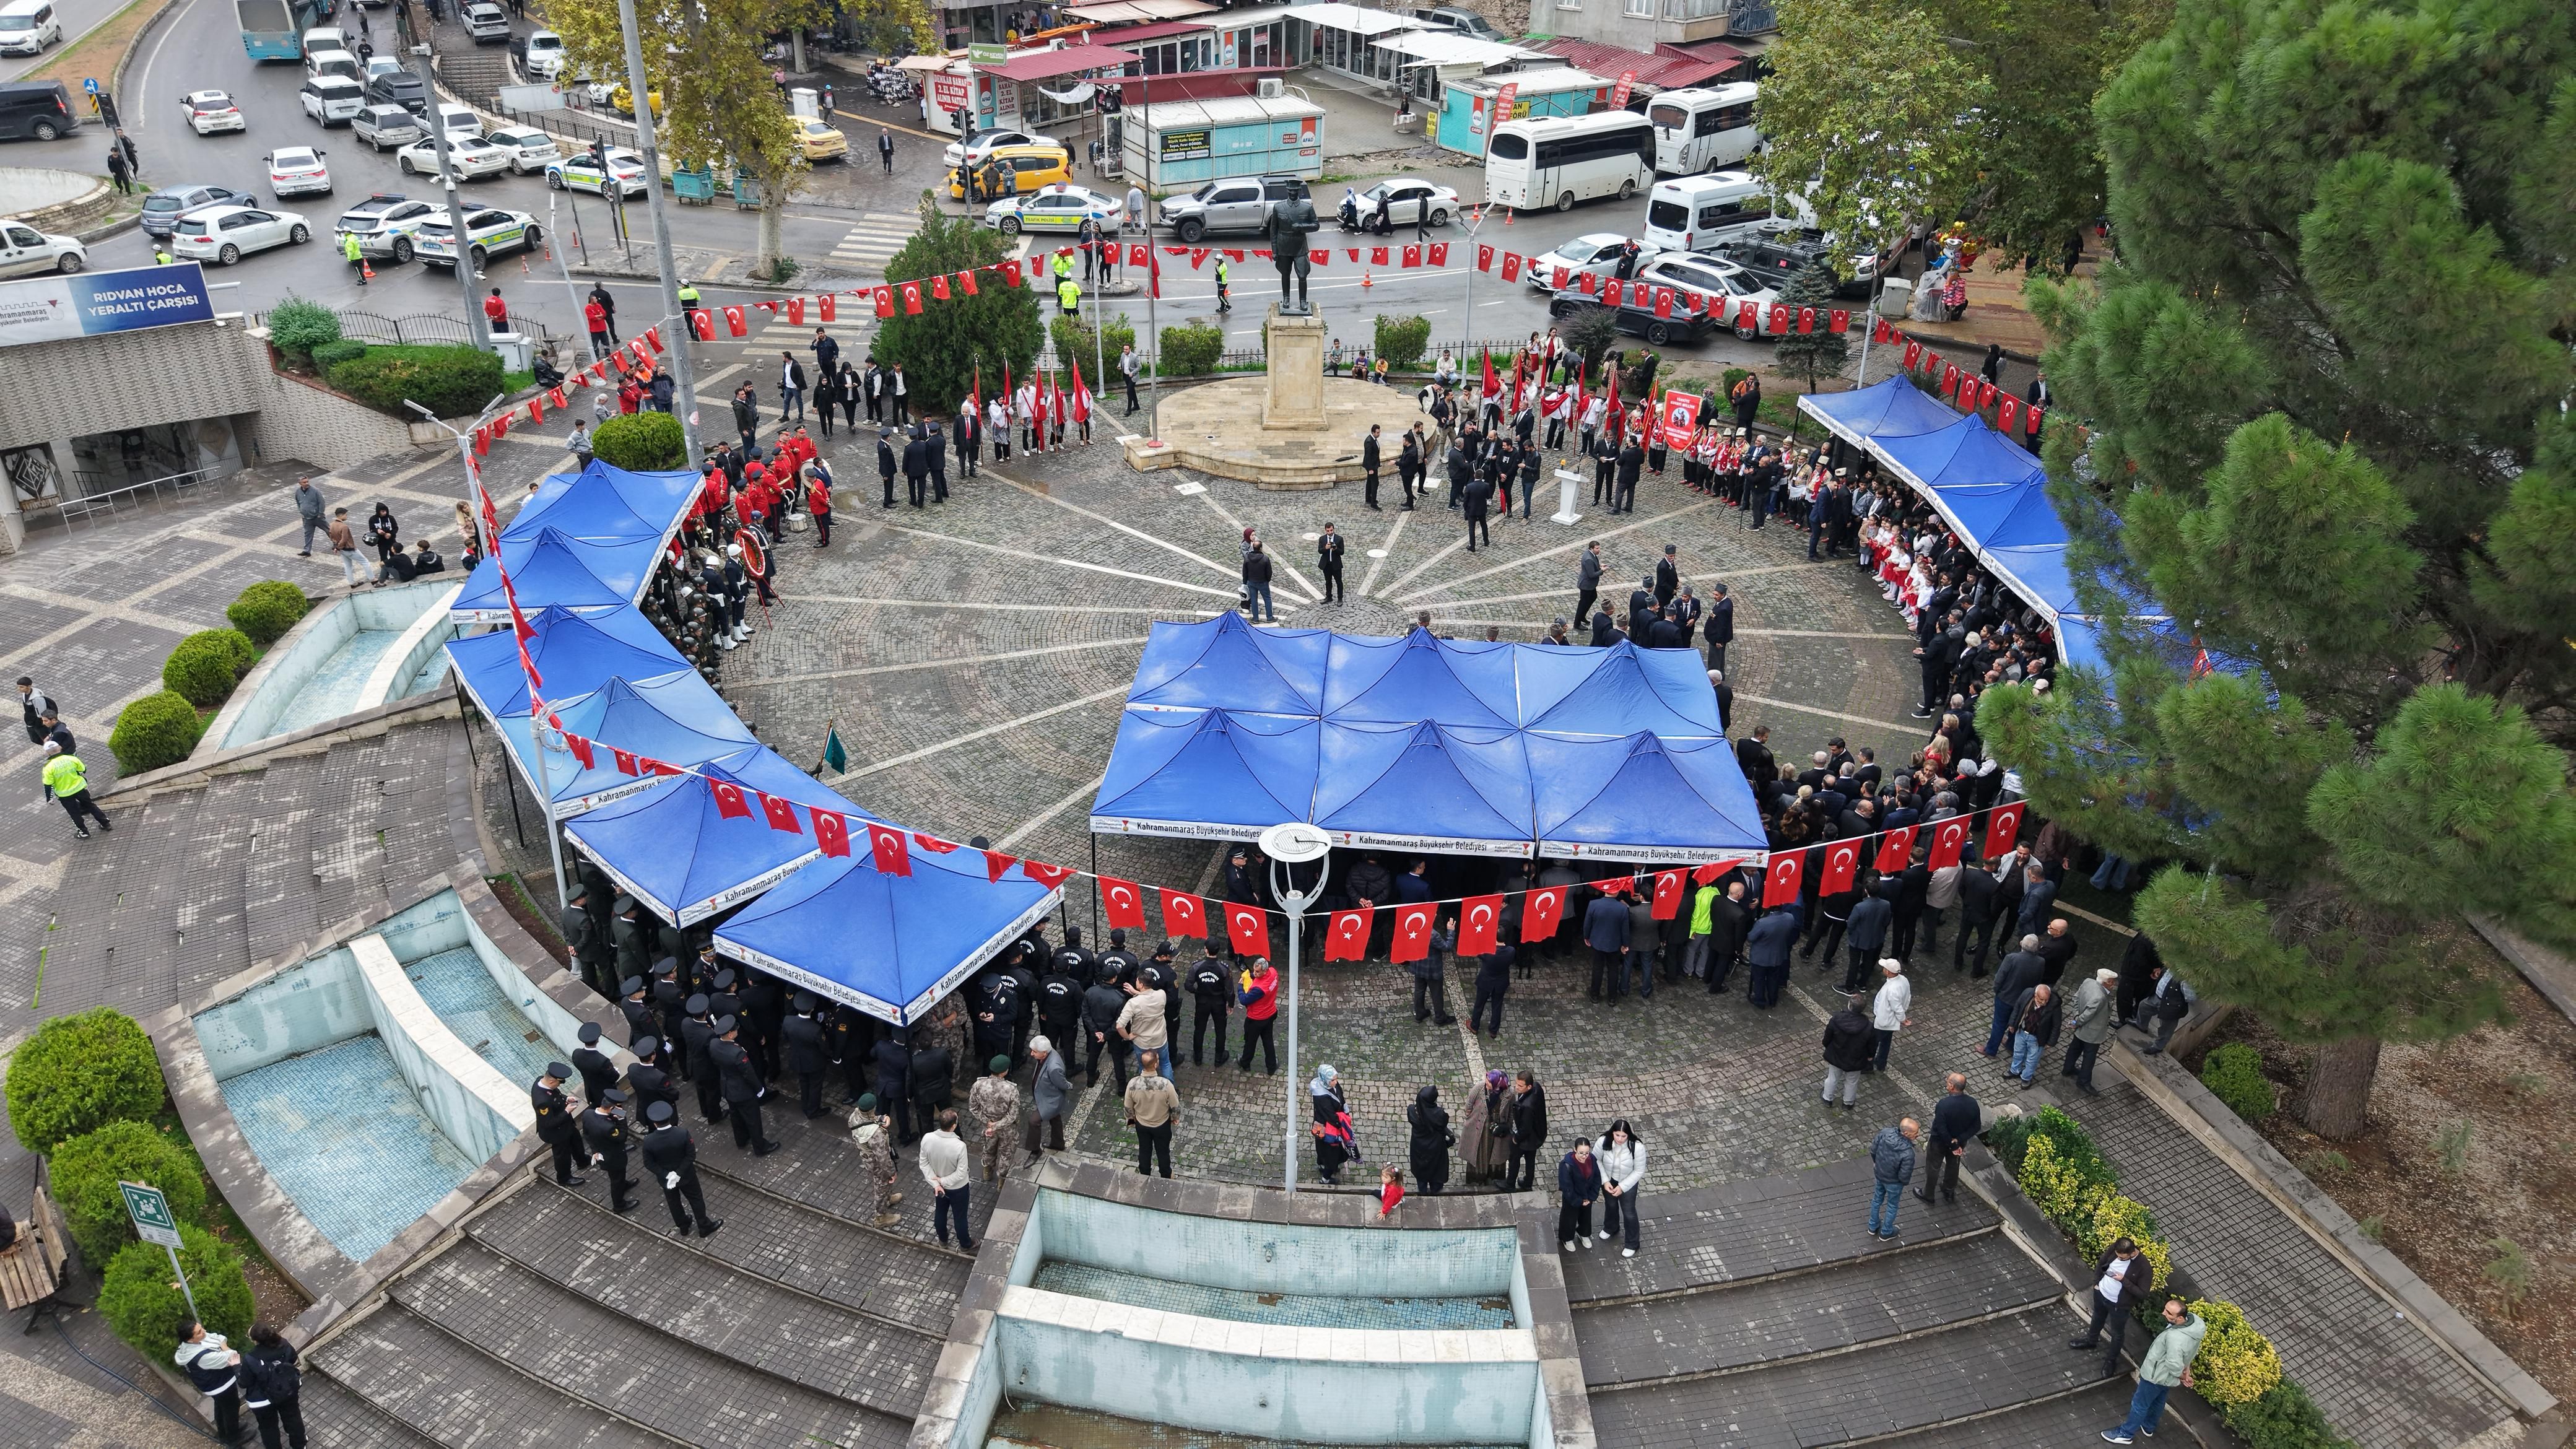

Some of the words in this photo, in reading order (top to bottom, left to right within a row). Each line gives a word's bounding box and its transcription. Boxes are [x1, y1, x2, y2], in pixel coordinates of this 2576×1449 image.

[952, 77, 967, 87] SAHAF
[943, 85, 950, 94] EL
[950, 85, 965, 96] KİTAP
[1510, 111, 1526, 119] FÖRÜ
[94, 287, 145, 303] RIDVAN
[146, 283, 186, 297] HOCA
[88, 301, 145, 318] YERALTI
[147, 295, 199, 312] ÇARŞISI
[23, 316, 50, 325] Belediyesi
[1137, 822, 1194, 834] Kahramanmaraş
[1196, 826, 1230, 837] Büyükşehir
[1231, 829, 1262, 838] Belediyesi
[1359, 835, 1418, 848] Kahramanmaraş
[1420, 838, 1453, 850] Büyükşehir
[1455, 841, 1487, 852] Belediyesi
[1588, 846, 1649, 859] Kahramanmaraş
[1651, 849, 1686, 859] Büyükşehir
[1687, 851, 1720, 861] Belediyesi
[724, 871, 781, 903] Kahramanmaraş
[940, 951, 986, 992] Kahramanmaraş
[986, 931, 1011, 957] Büyükşehir
[1011, 911, 1034, 936] Belediyesi
[752, 953, 803, 983] Kahramanmaraş
[803, 972, 833, 994] Büyükşehir
[833, 985, 861, 1005] Belediyesi
